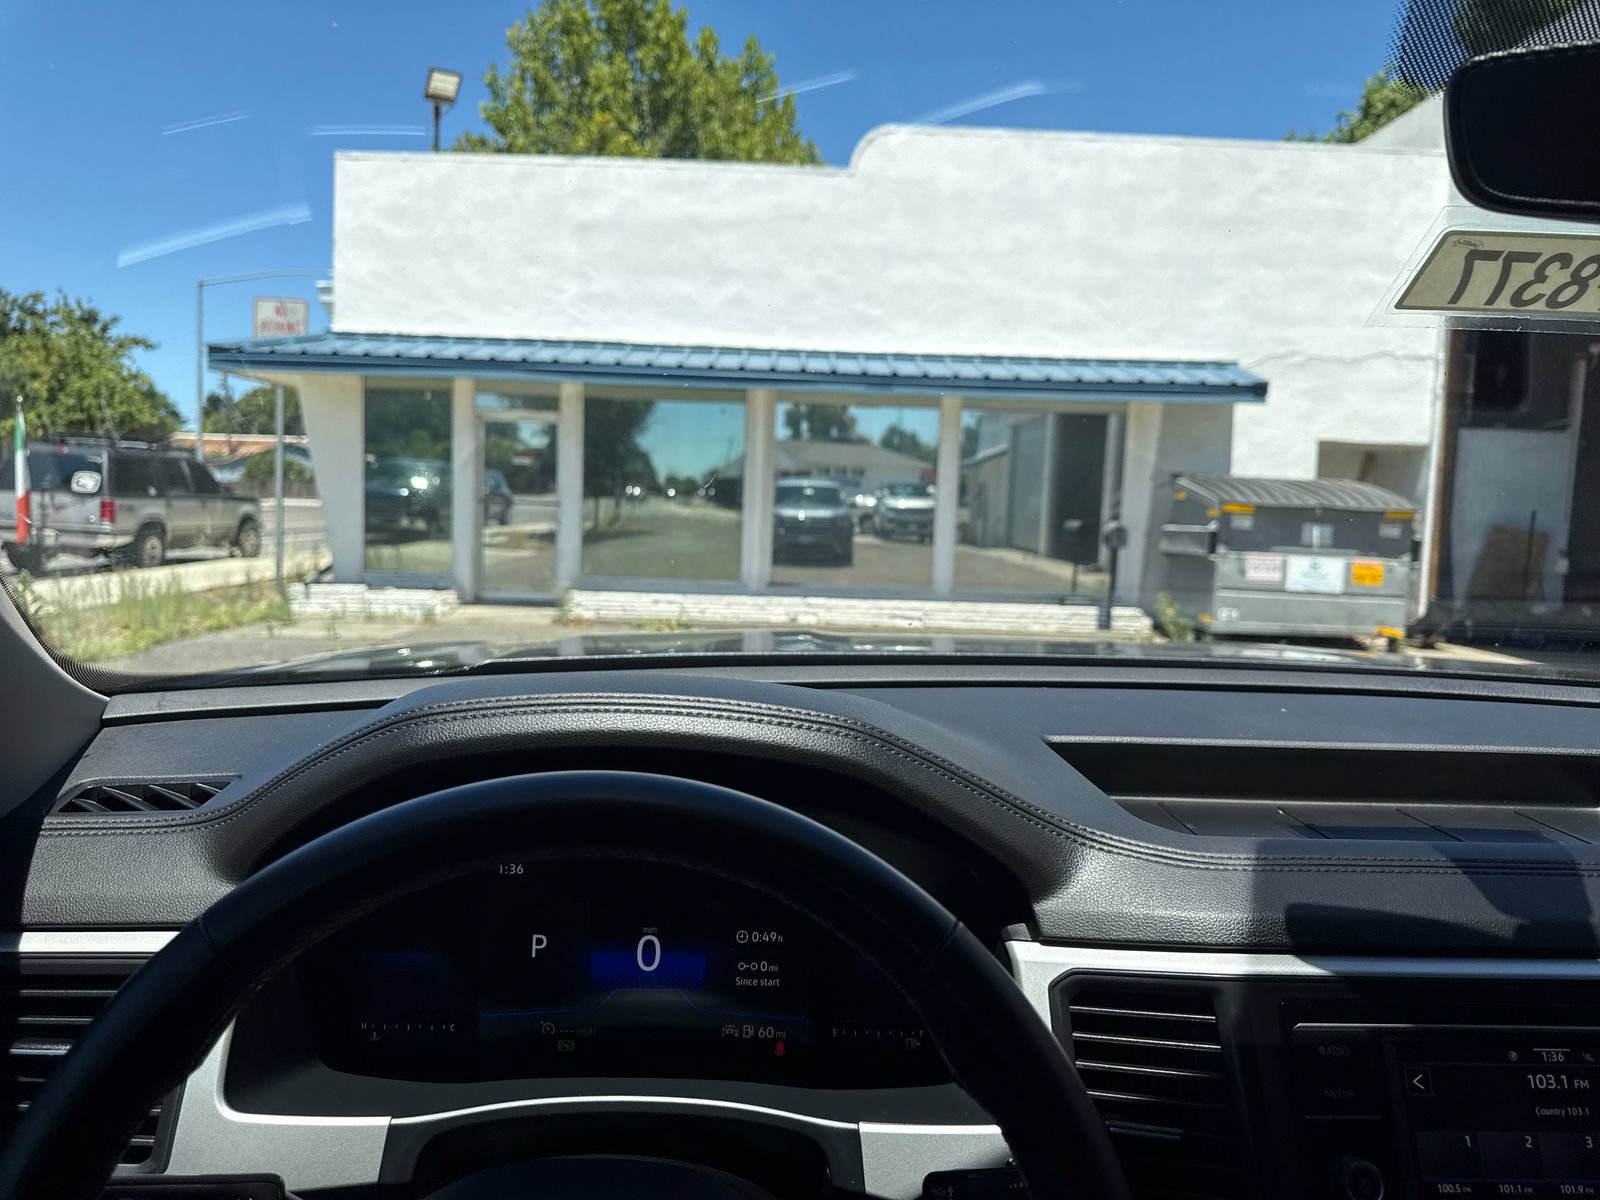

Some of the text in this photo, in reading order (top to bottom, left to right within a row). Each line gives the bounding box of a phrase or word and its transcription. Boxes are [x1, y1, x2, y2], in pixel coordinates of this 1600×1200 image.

[531, 934, 548, 959] P
[636, 935, 661, 972] 0
[735, 977, 780, 987] Since start
[1541, 1051, 1565, 1063] 1:36
[1527, 1074, 1590, 1089] 103.1 FM
[1535, 1106, 1590, 1118] Country 103.1
[1464, 1135, 1472, 1148] 1
[1524, 1135, 1533, 1149] 2
[1584, 1135, 1594, 1149] 3
[1437, 1183, 1462, 1194] 100.5
[1499, 1184, 1522, 1195] 101.1
[1560, 1184, 1584, 1195] 101.9
